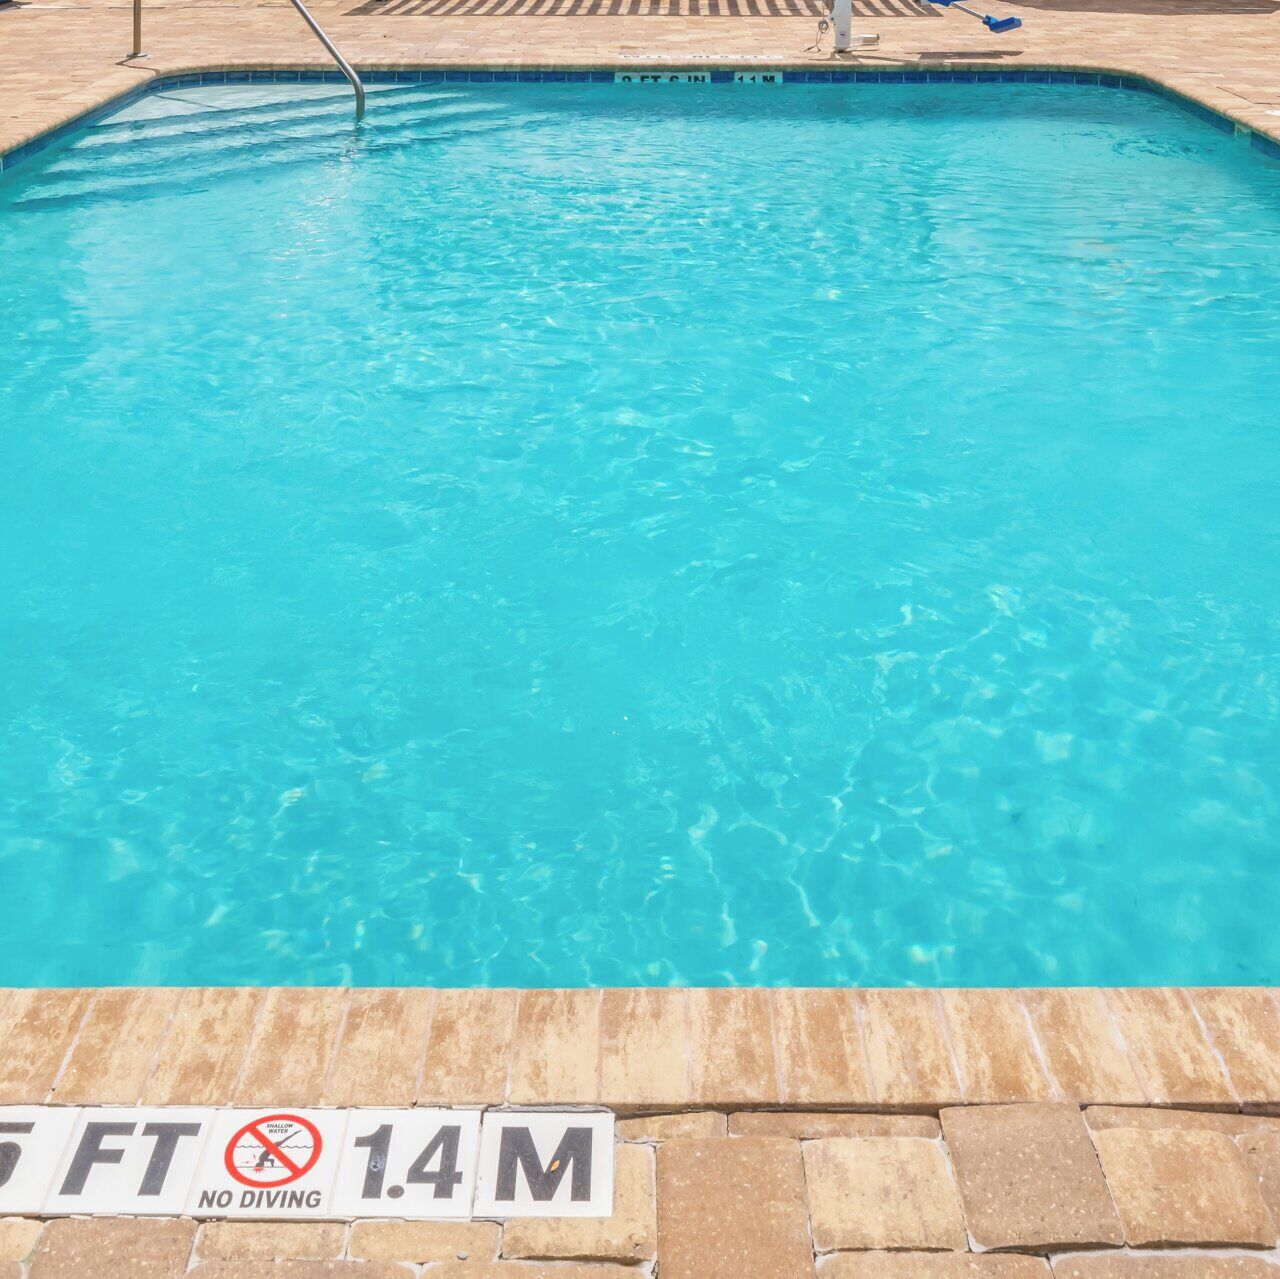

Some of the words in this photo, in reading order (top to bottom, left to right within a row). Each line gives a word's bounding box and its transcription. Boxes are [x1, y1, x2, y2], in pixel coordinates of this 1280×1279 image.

[58, 1121, 202, 1197] FT
[353, 1123, 463, 1200] 1.4
[494, 1126, 594, 1202] M
[197, 1190, 233, 1210] NO
[238, 1190, 323, 1209] DIVING
